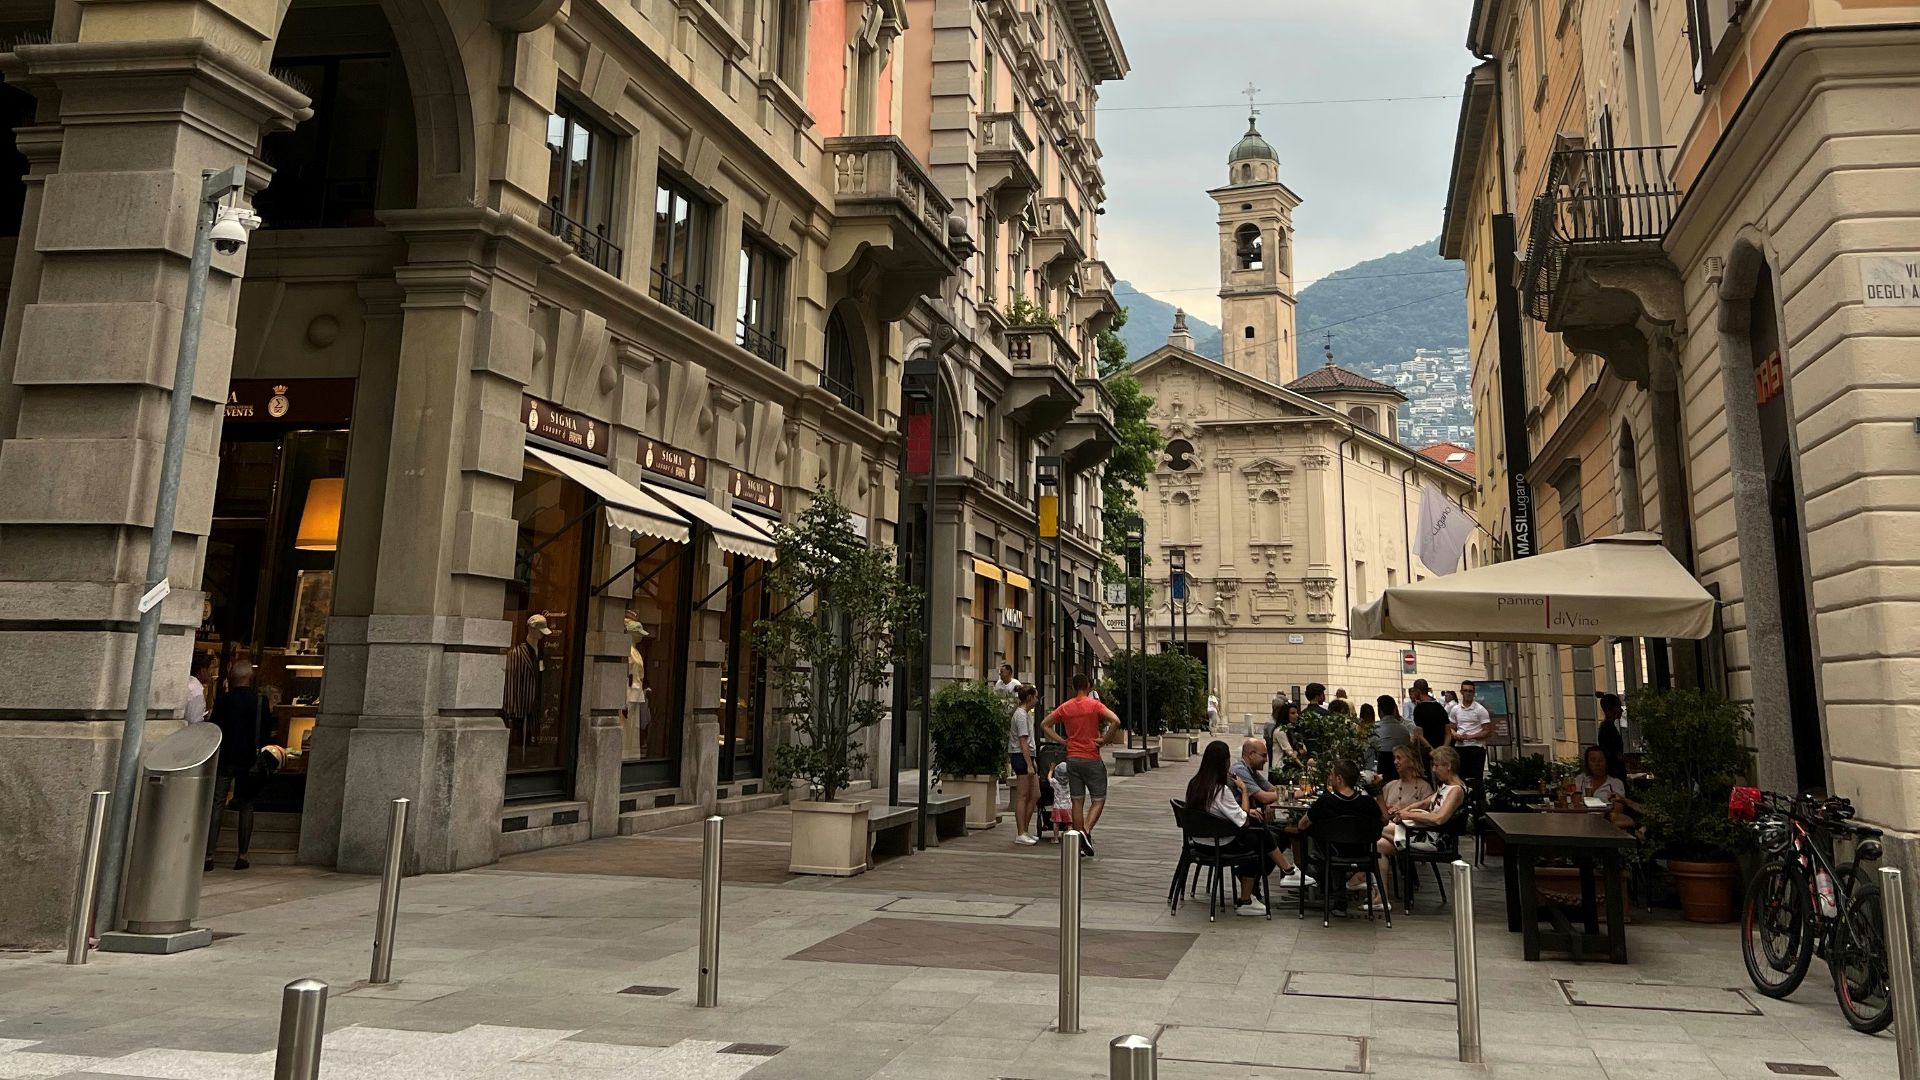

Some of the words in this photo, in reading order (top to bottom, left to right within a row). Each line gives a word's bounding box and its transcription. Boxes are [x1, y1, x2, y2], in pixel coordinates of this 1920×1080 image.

[1905, 263, 1920, 279] VI
[1867, 284, 1905, 299] DEGLI
[1912, 284, 1920, 299] A
[550, 410, 577, 431] SIGMA
[661, 450, 682, 466] SIGMA
[1497, 596, 1544, 611] panino
